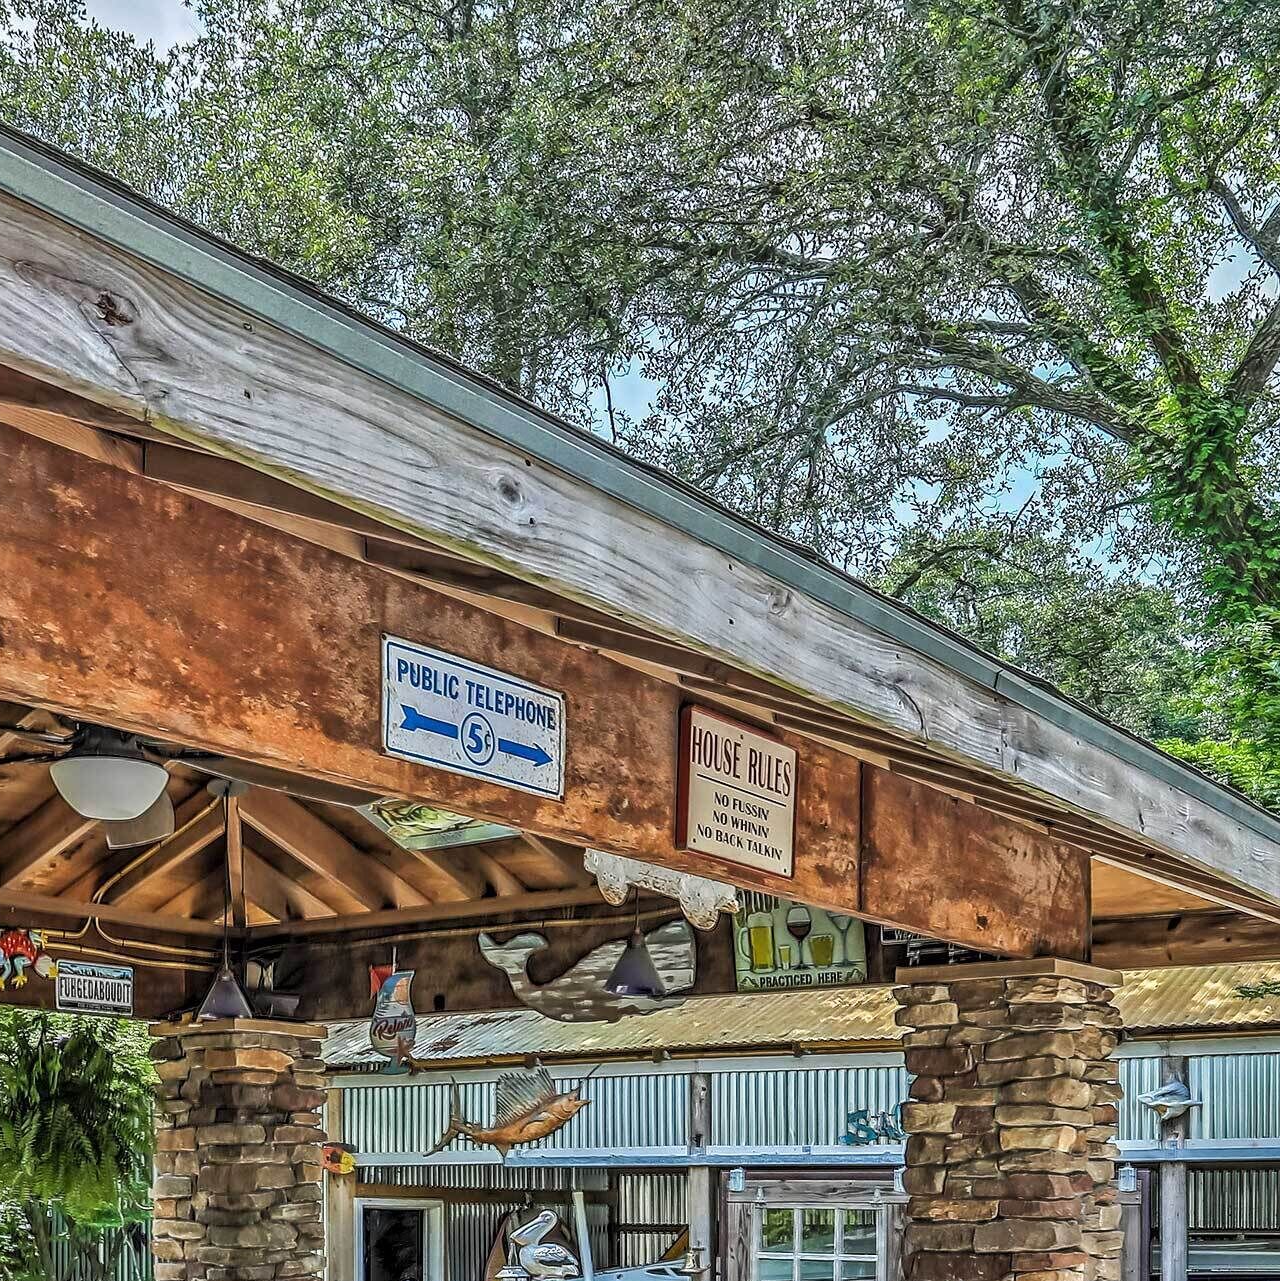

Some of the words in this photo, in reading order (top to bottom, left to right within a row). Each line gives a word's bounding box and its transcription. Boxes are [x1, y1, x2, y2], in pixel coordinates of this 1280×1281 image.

[397, 658, 459, 700] PUBLIC
[465, 680, 556, 731] TELEPHONE
[692, 725, 741, 779] HOUSE
[748, 747, 791, 797] RULES
[714, 791, 729, 807] NO
[712, 810, 728, 826] NO
[697, 823, 712, 839] NO
[715, 830, 744, 849] BACK
[759, 973, 812, 988] PRACTICED
[818, 971, 843, 985] HERE
